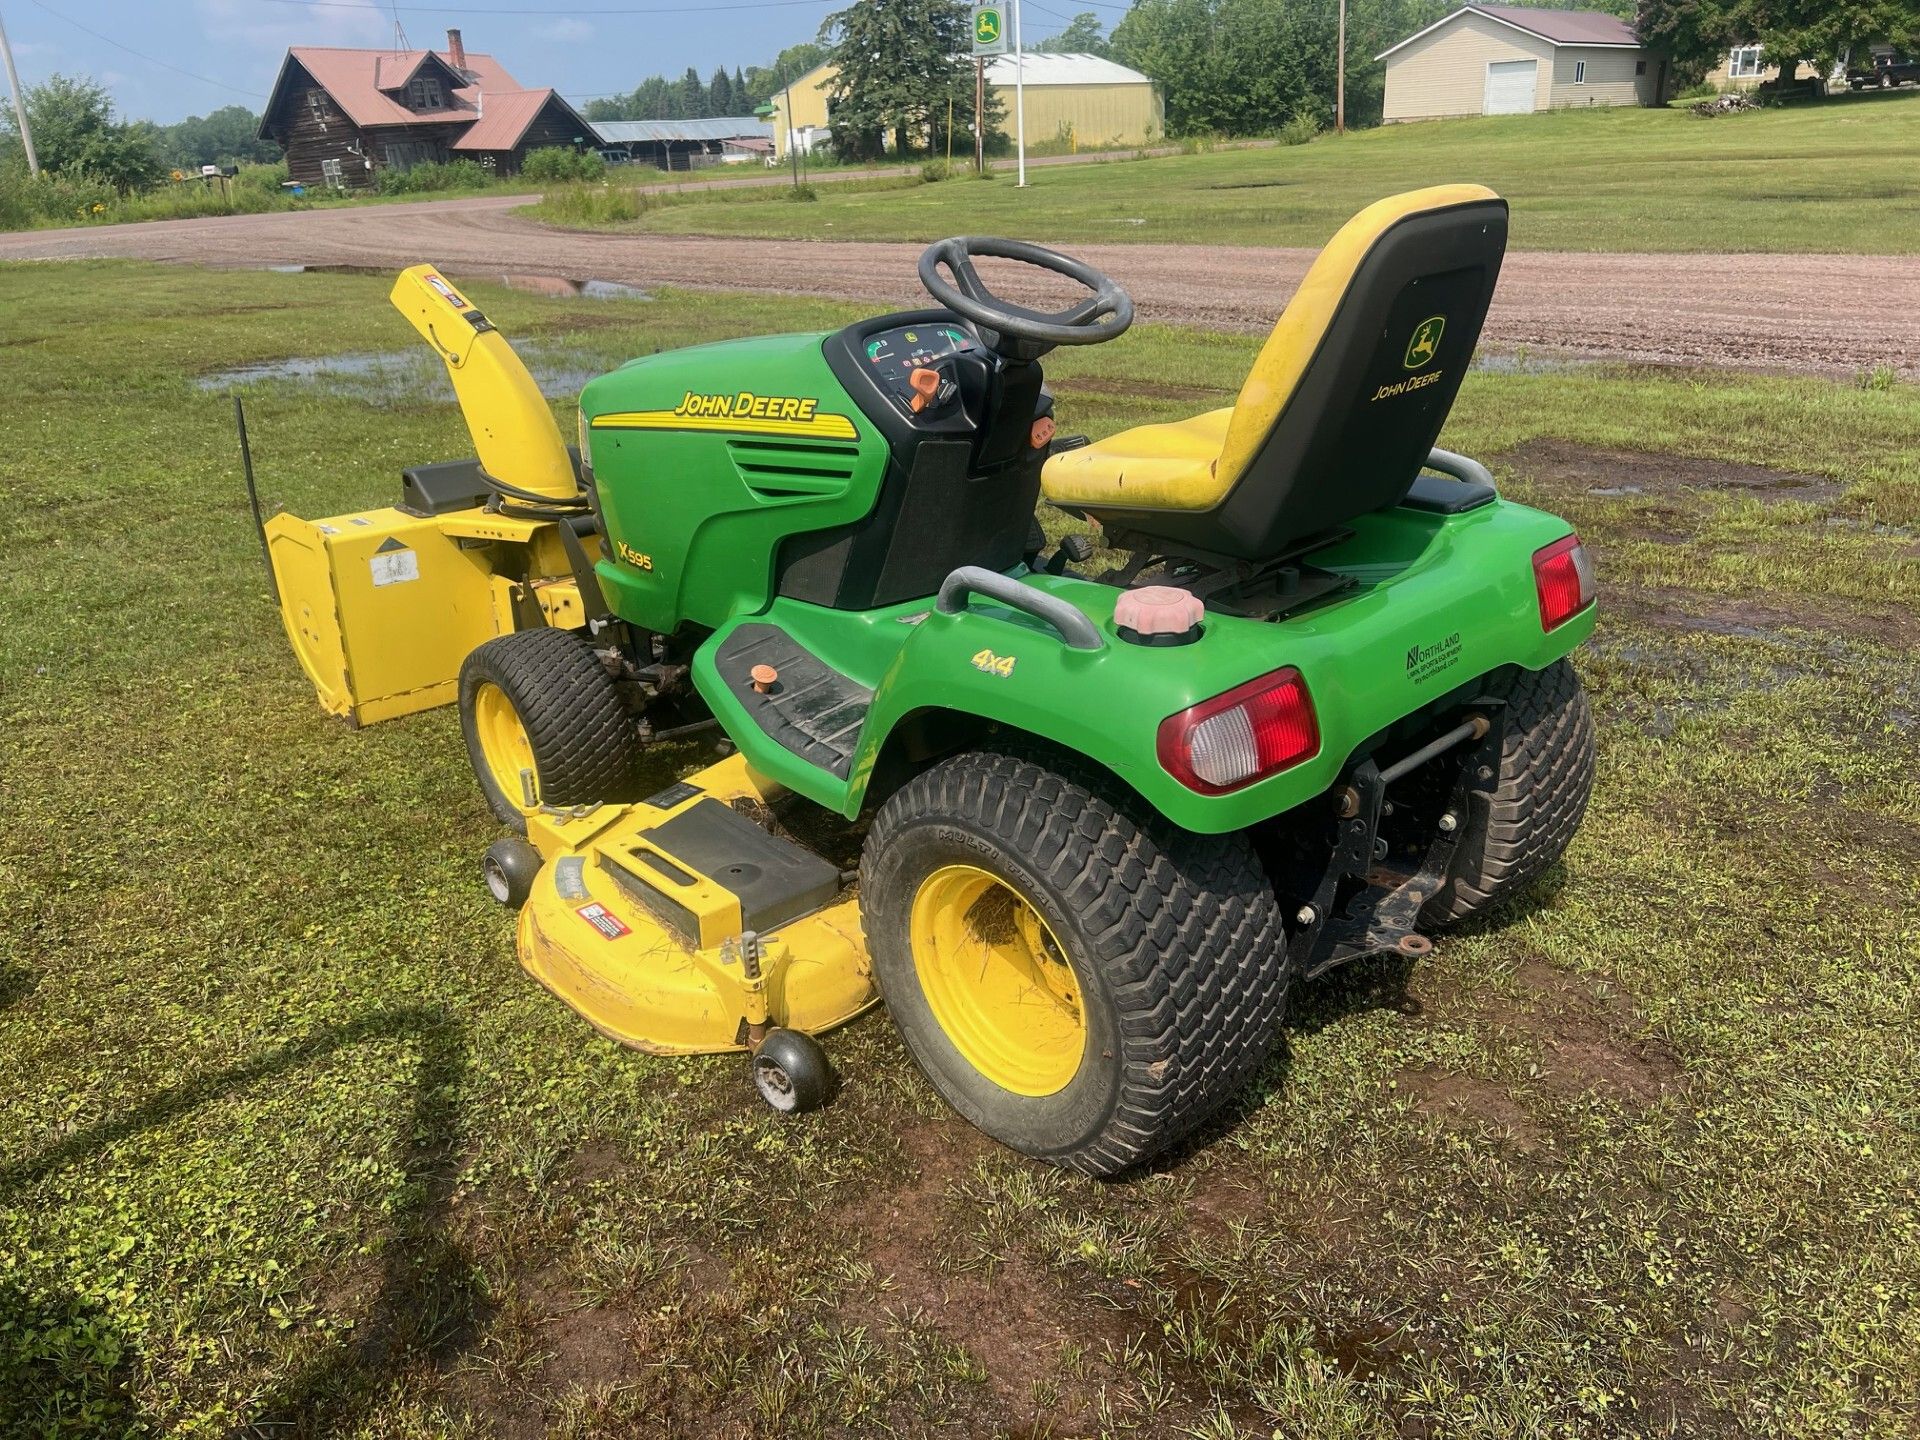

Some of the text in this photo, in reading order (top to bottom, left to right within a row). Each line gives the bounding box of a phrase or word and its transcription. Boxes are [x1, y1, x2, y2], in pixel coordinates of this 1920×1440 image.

[1371, 370, 1443, 402] JOHN DEERE
[674, 390, 818, 421] JOHN DEERE
[617, 540, 653, 571] X595
[938, 829, 1000, 860] MULTI
